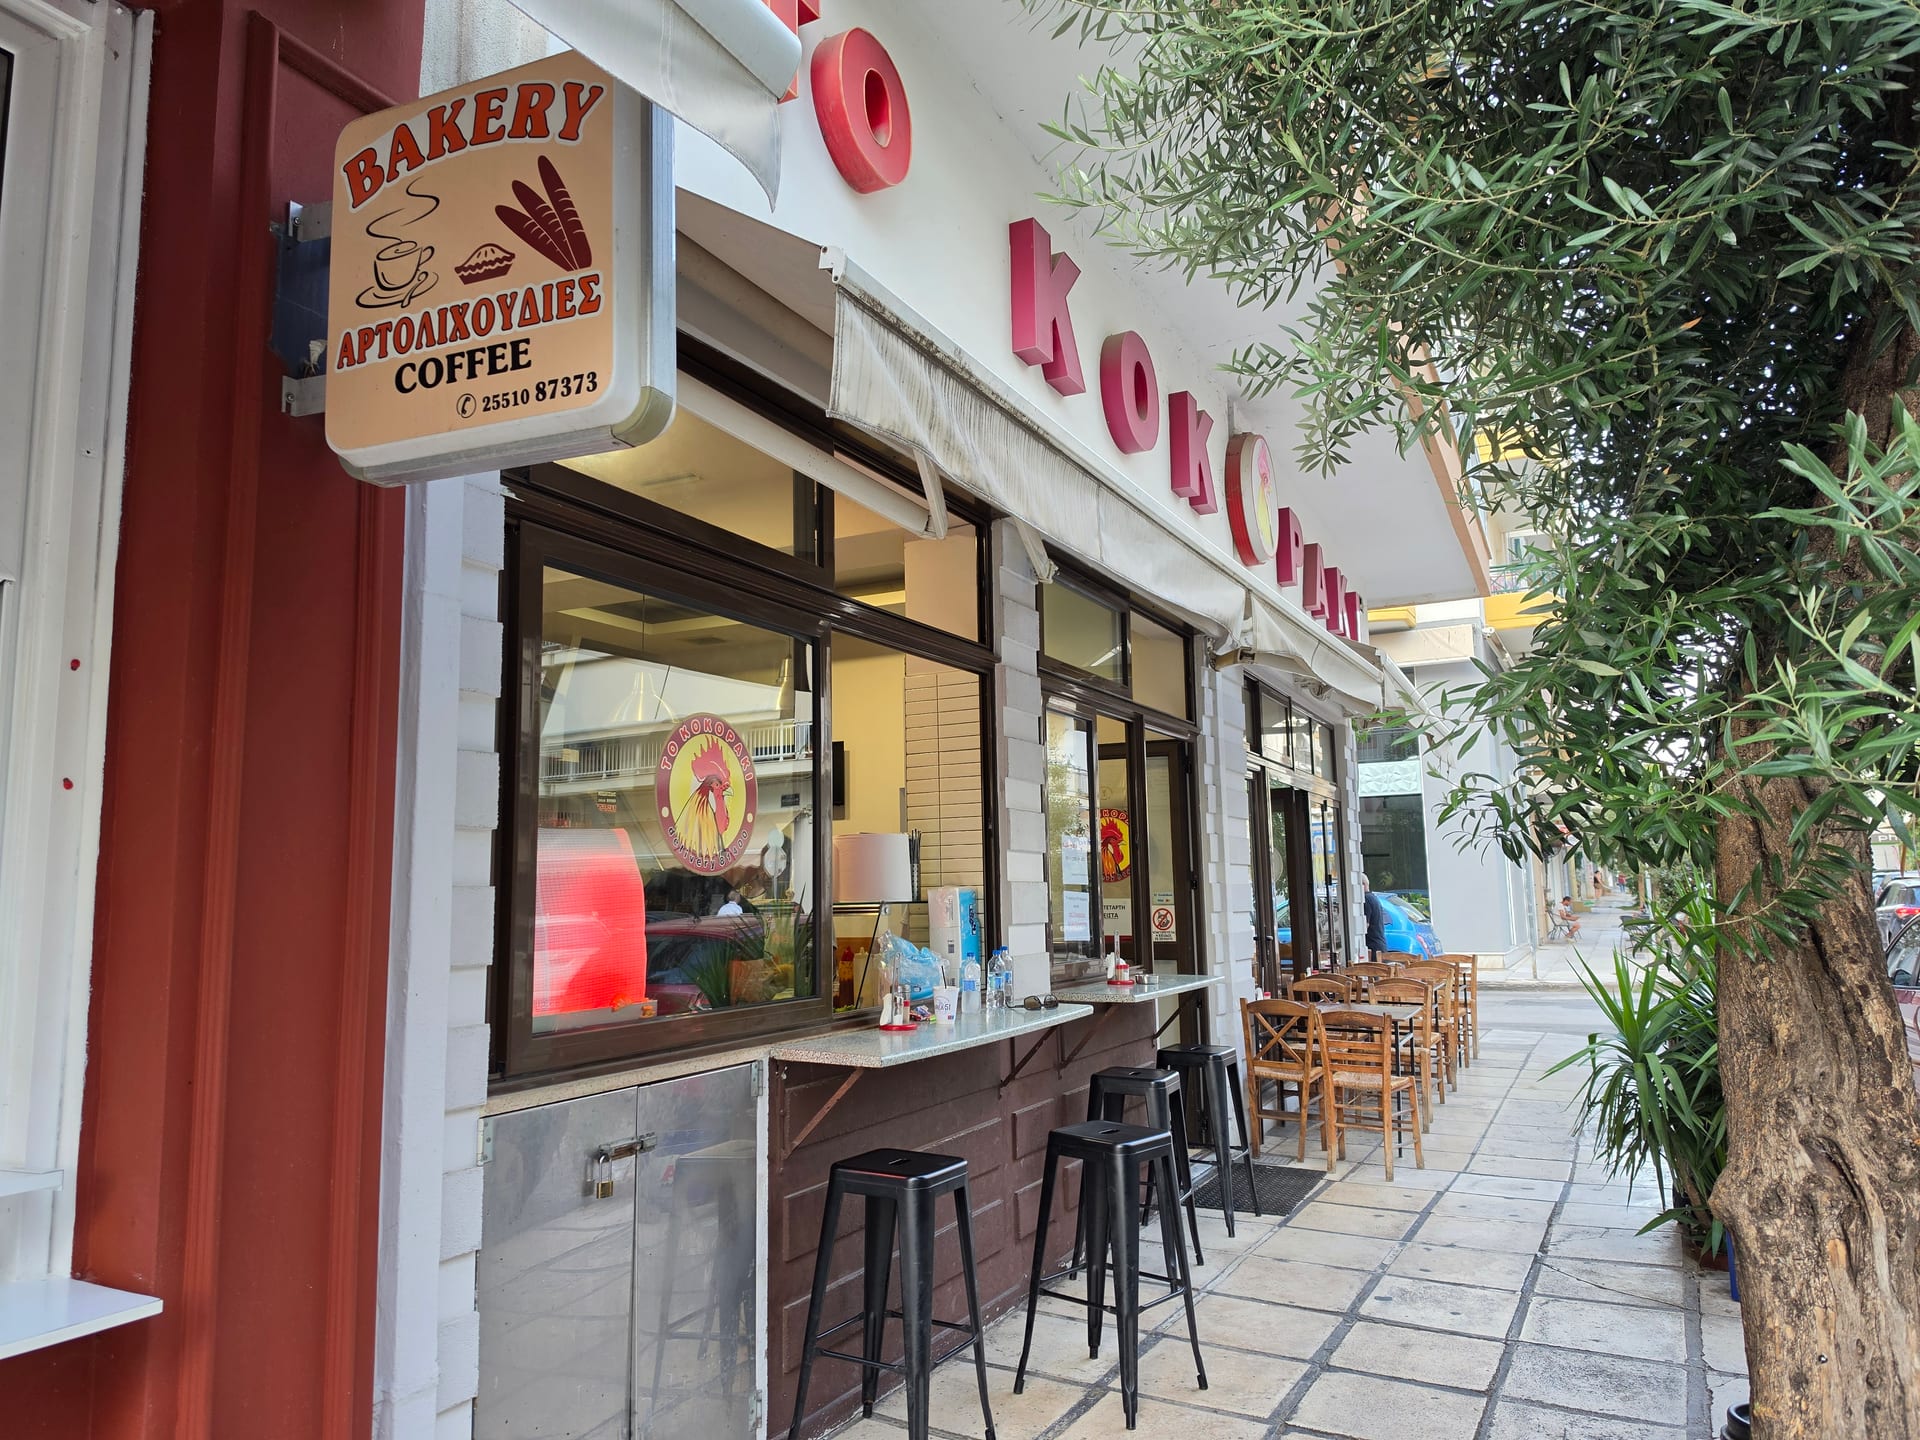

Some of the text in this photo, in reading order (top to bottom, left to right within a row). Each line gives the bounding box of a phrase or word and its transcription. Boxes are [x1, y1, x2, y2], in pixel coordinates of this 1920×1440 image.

[342, 82, 604, 209] BAKERY
[337, 274, 602, 370] ΑΡΤΟΛΙΧΟΥΔΙΕΣ
[394, 338, 532, 394] COFFEE
[482, 371, 598, 412] 25510 87373
[668, 825, 716, 872] delivery
